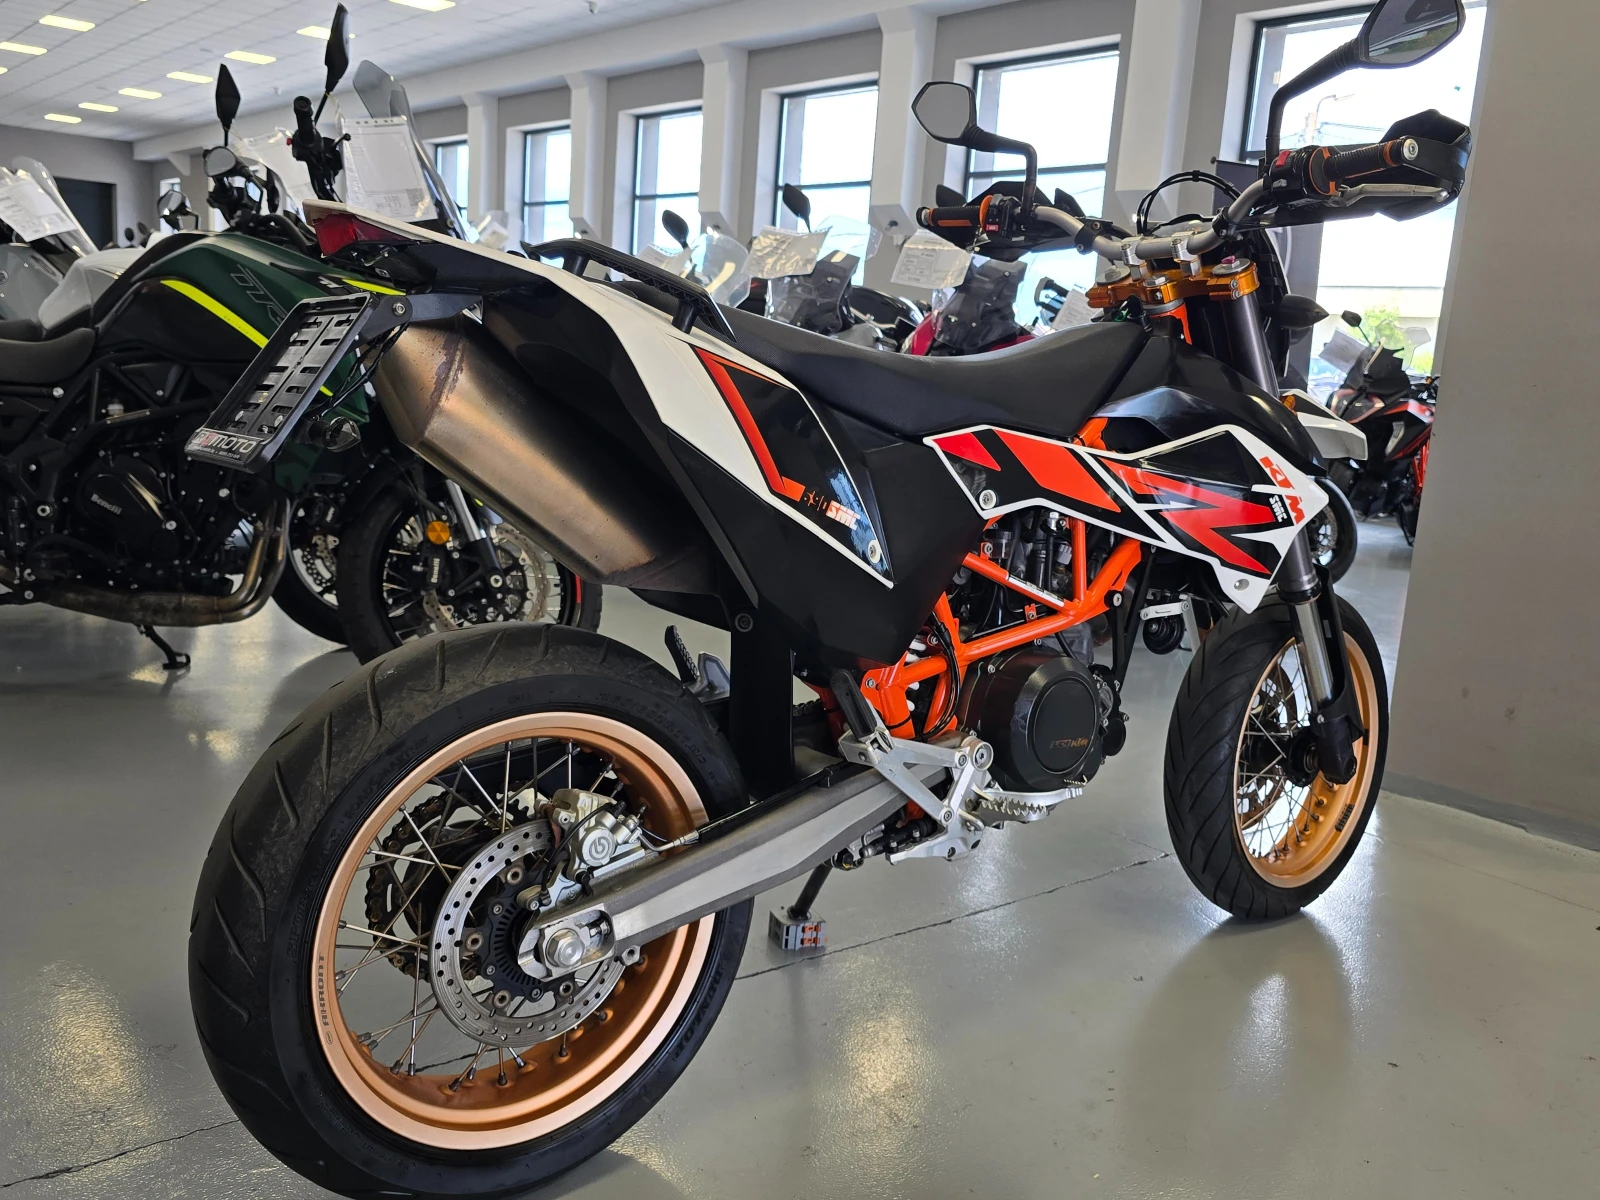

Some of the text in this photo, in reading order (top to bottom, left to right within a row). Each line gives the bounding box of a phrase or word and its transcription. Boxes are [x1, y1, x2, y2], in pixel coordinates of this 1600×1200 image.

[91, 493, 122, 515] Benelli
[1258, 456, 1306, 525] KTM
[825, 500, 861, 531] SMC
[1268, 494, 1288, 523] SMC
[675, 967, 725, 1058] DUNLOP
